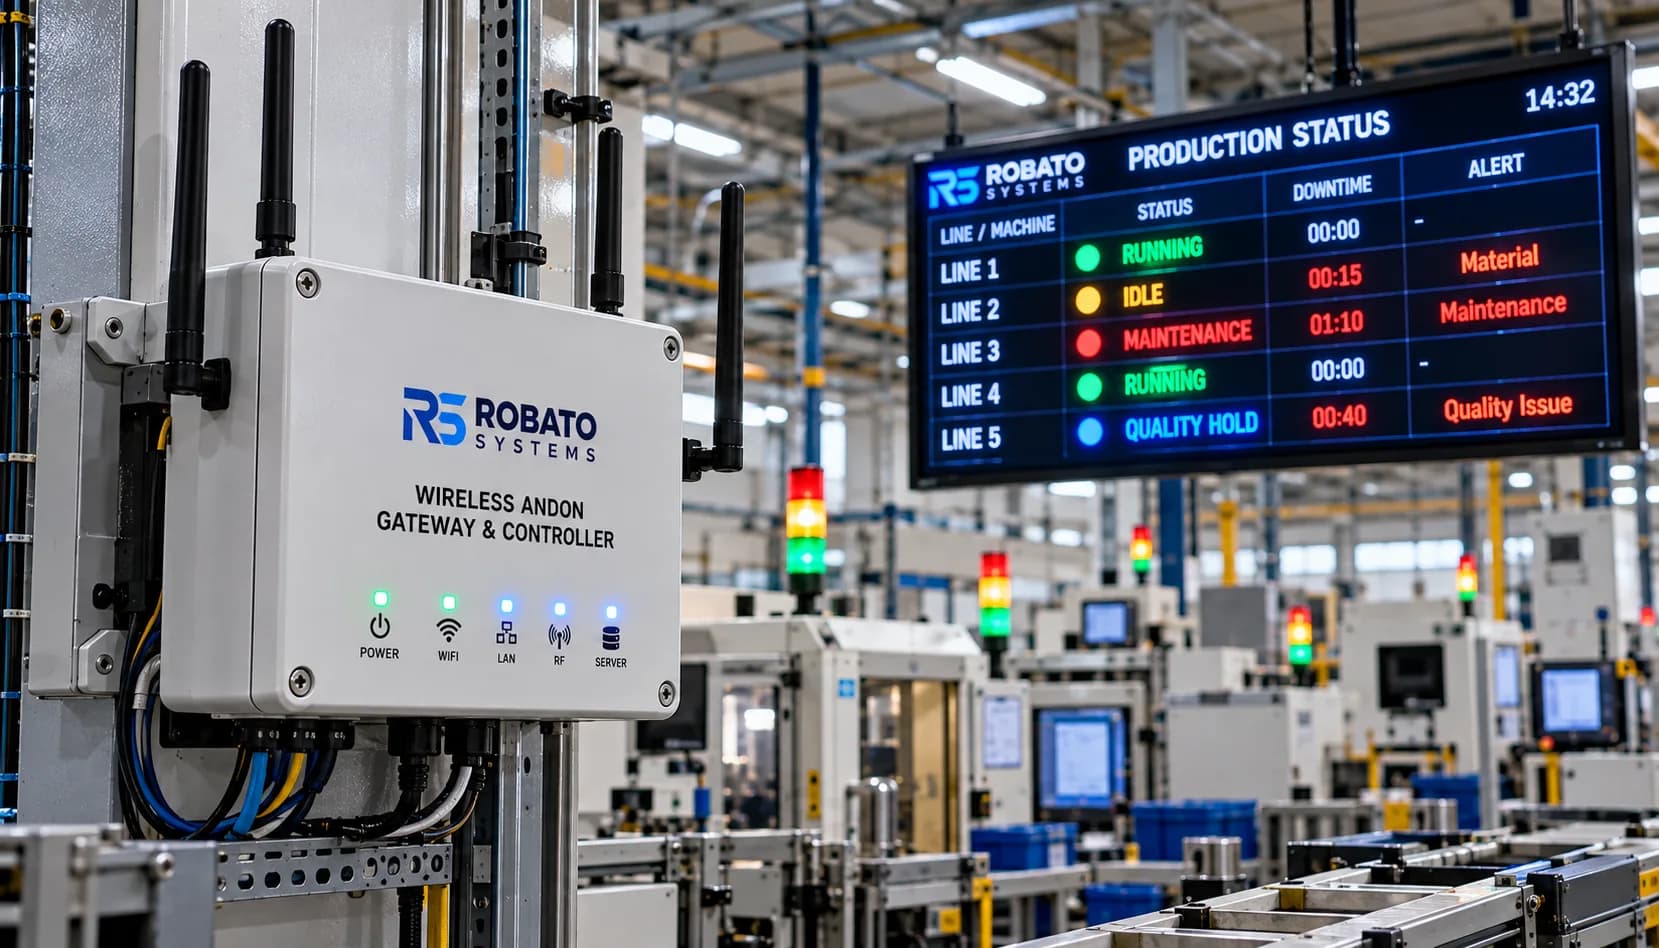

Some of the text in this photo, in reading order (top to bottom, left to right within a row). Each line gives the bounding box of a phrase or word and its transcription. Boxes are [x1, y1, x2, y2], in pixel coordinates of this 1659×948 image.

[1525, 78, 1596, 113] 14:32
[1128, 109, 1391, 172] PRODUCTION STATUS
[986, 151, 1086, 185] ROBATO
[1467, 152, 1525, 179] ALERT
[986, 176, 1085, 200] SYSTEMS
[1293, 174, 1373, 202] DOWNTIME
[1137, 197, 1194, 221] STATUS
[940, 214, 1056, 245] LINE / MACHINE
[1307, 217, 1360, 244] 00:00
[1122, 235, 1203, 265] RUNNING
[1461, 243, 1539, 274] Material
[940, 257, 1000, 284] LINE 1
[1308, 263, 1363, 289] 00:15
[1123, 282, 1164, 308] IDLE
[940, 297, 1000, 325] LINE 2
[1310, 310, 1364, 336] 01:10
[1440, 295, 1567, 324] Maintenance
[1123, 319, 1253, 351] MAINTENANCE
[941, 339, 1001, 366] LINE 3
[1124, 369, 1206, 396] RUNNING
[1311, 356, 1365, 382] 00:00
[941, 382, 1001, 408] LINE 4
[1444, 393, 1573, 424] Quality Issue
[475, 397, 597, 441] ROBATO
[1124, 410, 1259, 443] QUALITY HOLD
[1312, 403, 1367, 429] 00:40
[475, 433, 597, 463] SYSTEMS
[941, 425, 1002, 452] LINE 5
[415, 484, 584, 520] WIRELESS ANDON
[376, 510, 614, 549] GATEWAY & CONTROLLER
[359, 646, 400, 660] POWER
[438, 650, 459, 662] WIFI
[497, 653, 516, 664] LAN
[553, 655, 565, 666] RF
[595, 656, 627, 668] SERVER
